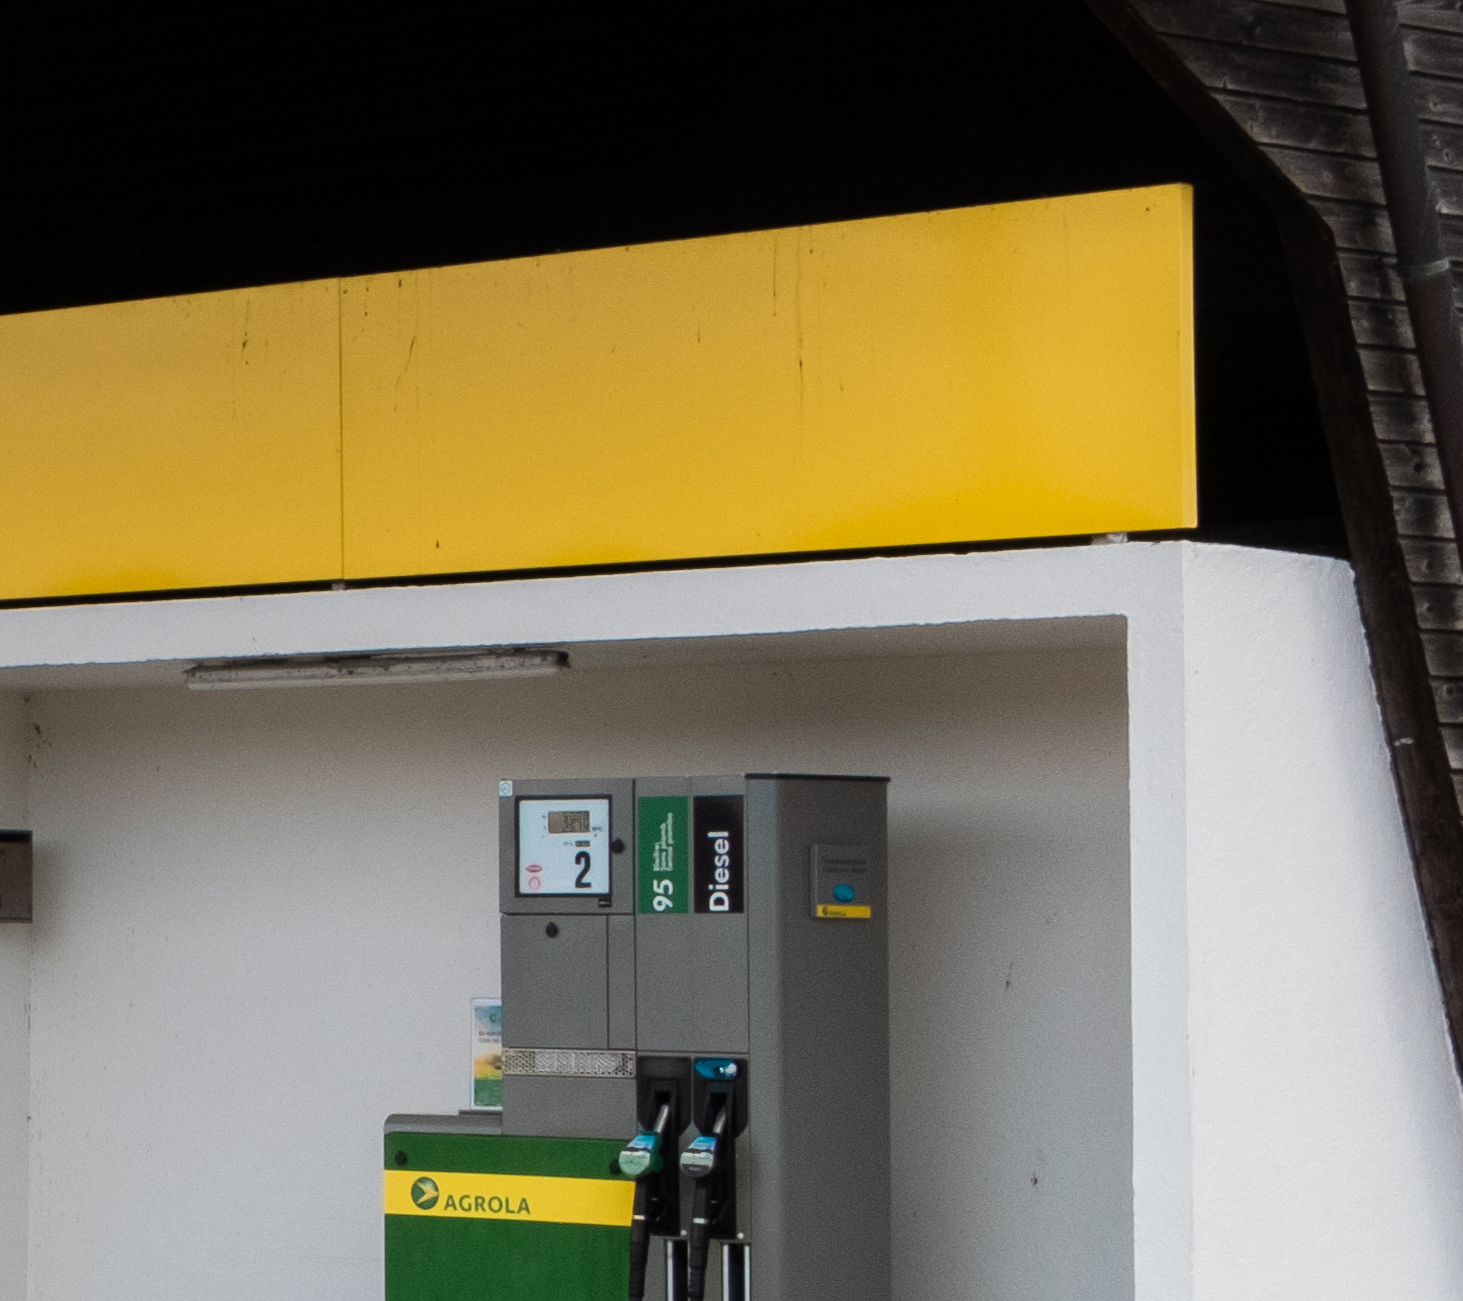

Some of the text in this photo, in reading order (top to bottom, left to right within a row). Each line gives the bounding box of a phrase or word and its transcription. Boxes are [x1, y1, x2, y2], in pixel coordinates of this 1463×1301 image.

[575, 850, 592, 889] 2
[707, 831, 729, 912] Diesel
[653, 879, 673, 912] 95
[444, 1194, 531, 1215] AGROLA
